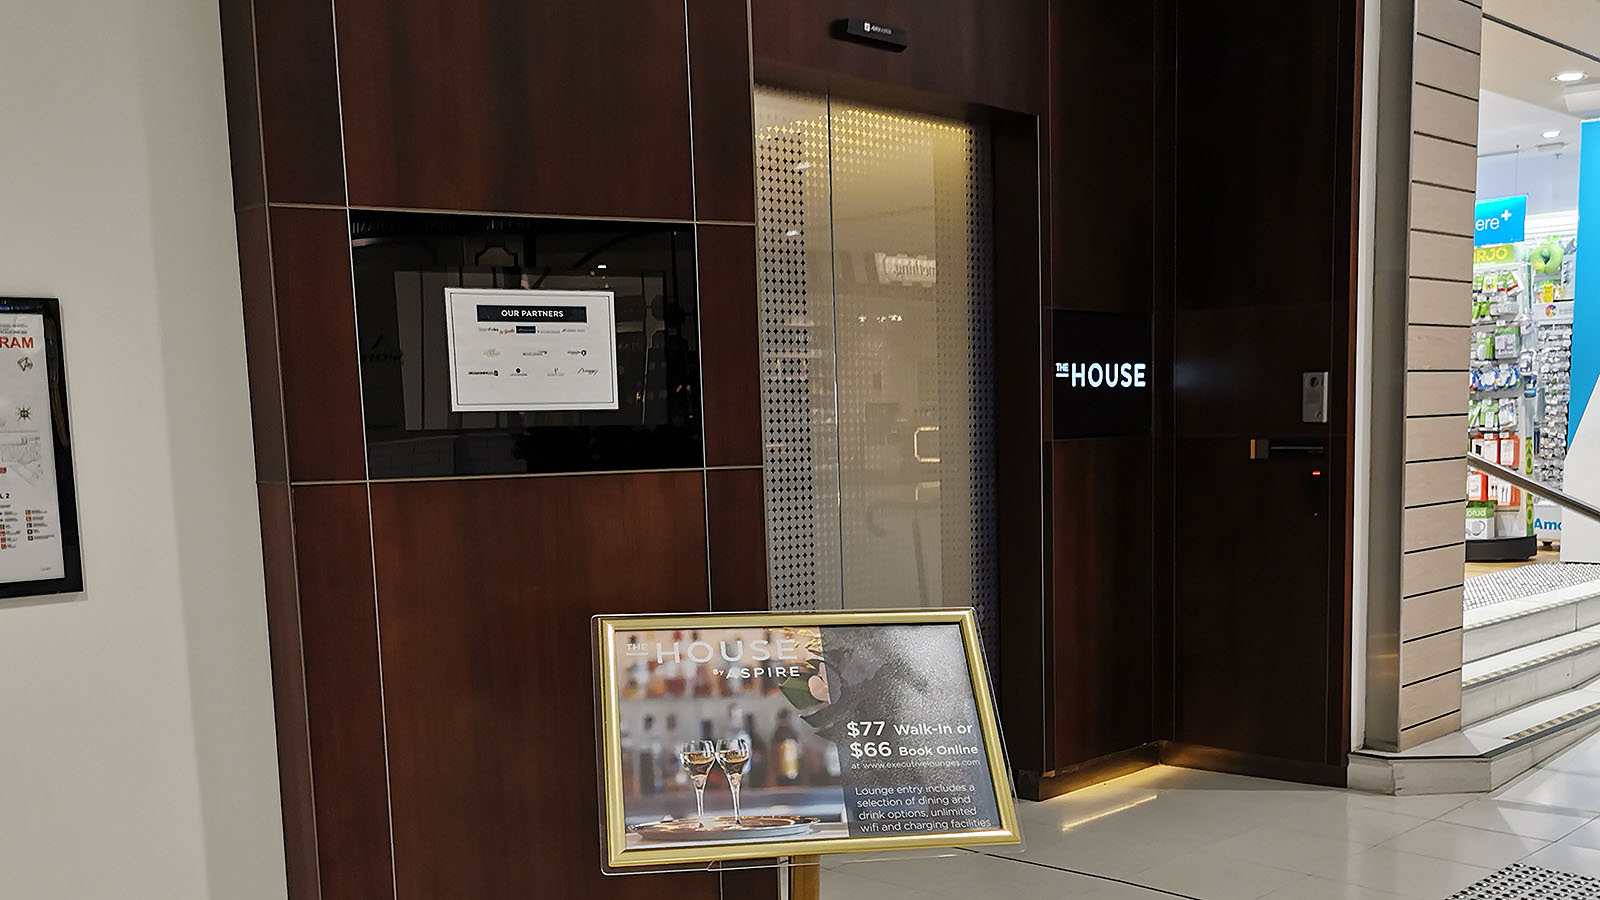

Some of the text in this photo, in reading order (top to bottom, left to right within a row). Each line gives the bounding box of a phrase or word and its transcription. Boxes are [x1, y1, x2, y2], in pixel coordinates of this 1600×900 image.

[501, 309, 564, 318] OUR PARTNERS
[1055, 362, 1147, 387] THE HOUSE
[626, 638, 798, 664] THE HOUSE
[726, 666, 801, 679] ASPIRE
[846, 720, 886, 738] $77
[957, 724, 973, 735] or
[849, 741, 979, 759] $66 Book Online
[851, 759, 981, 770] at www.executivelounges.com
[855, 786, 894, 797] Lounge
[896, 785, 923, 796] entry
[925, 784, 967, 793] includes
[857, 795, 971, 807] selection of dining and
[858, 807, 977, 820] drink options, unlimited
[860, 818, 992, 833] wifi and charging facilities
